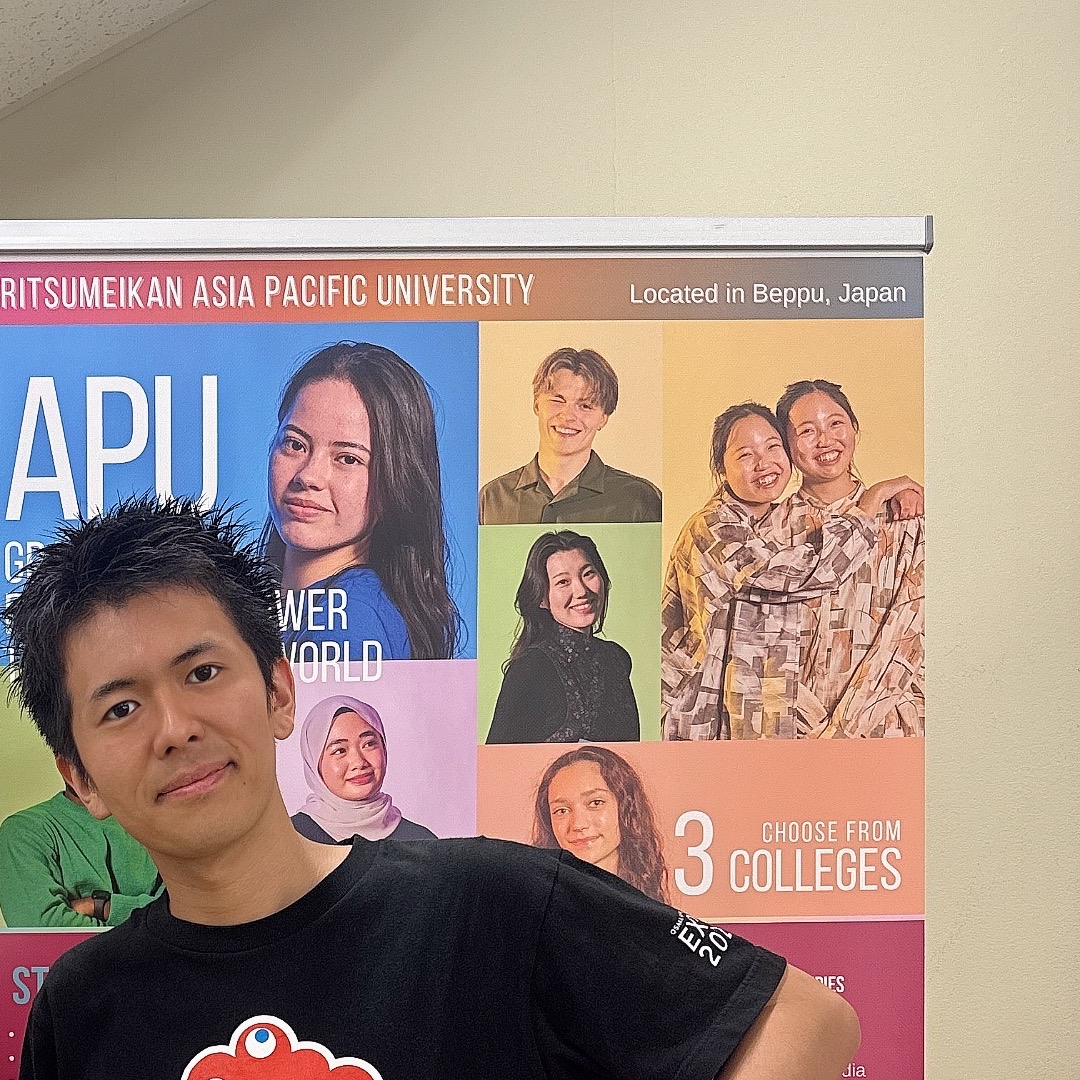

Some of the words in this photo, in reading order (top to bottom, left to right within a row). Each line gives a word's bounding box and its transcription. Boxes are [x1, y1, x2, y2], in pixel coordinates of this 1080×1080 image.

[0, 275, 184, 310] RITSUMEIKAN
[192, 275, 255, 309] ASIA
[265, 274, 368, 308] PACIFIC
[377, 272, 537, 307] UNIVERSITY
[630, 283, 719, 304] Located
[726, 283, 745, 303] in
[752, 283, 832, 309] Beppu,
[838, 283, 907, 308] Japan
[5, 374, 219, 521] APU
[275, 588, 348, 632] WER
[761, 820, 838, 844] CHOOSE
[845, 819, 902, 842] FROM
[673, 809, 715, 896] 3
[729, 847, 903, 893] COLLEGES
[677, 914, 709, 953] EX
[698, 926, 733, 967] 20
[12, 966, 50, 1005] ST
[841, 1062, 867, 1078] dia
